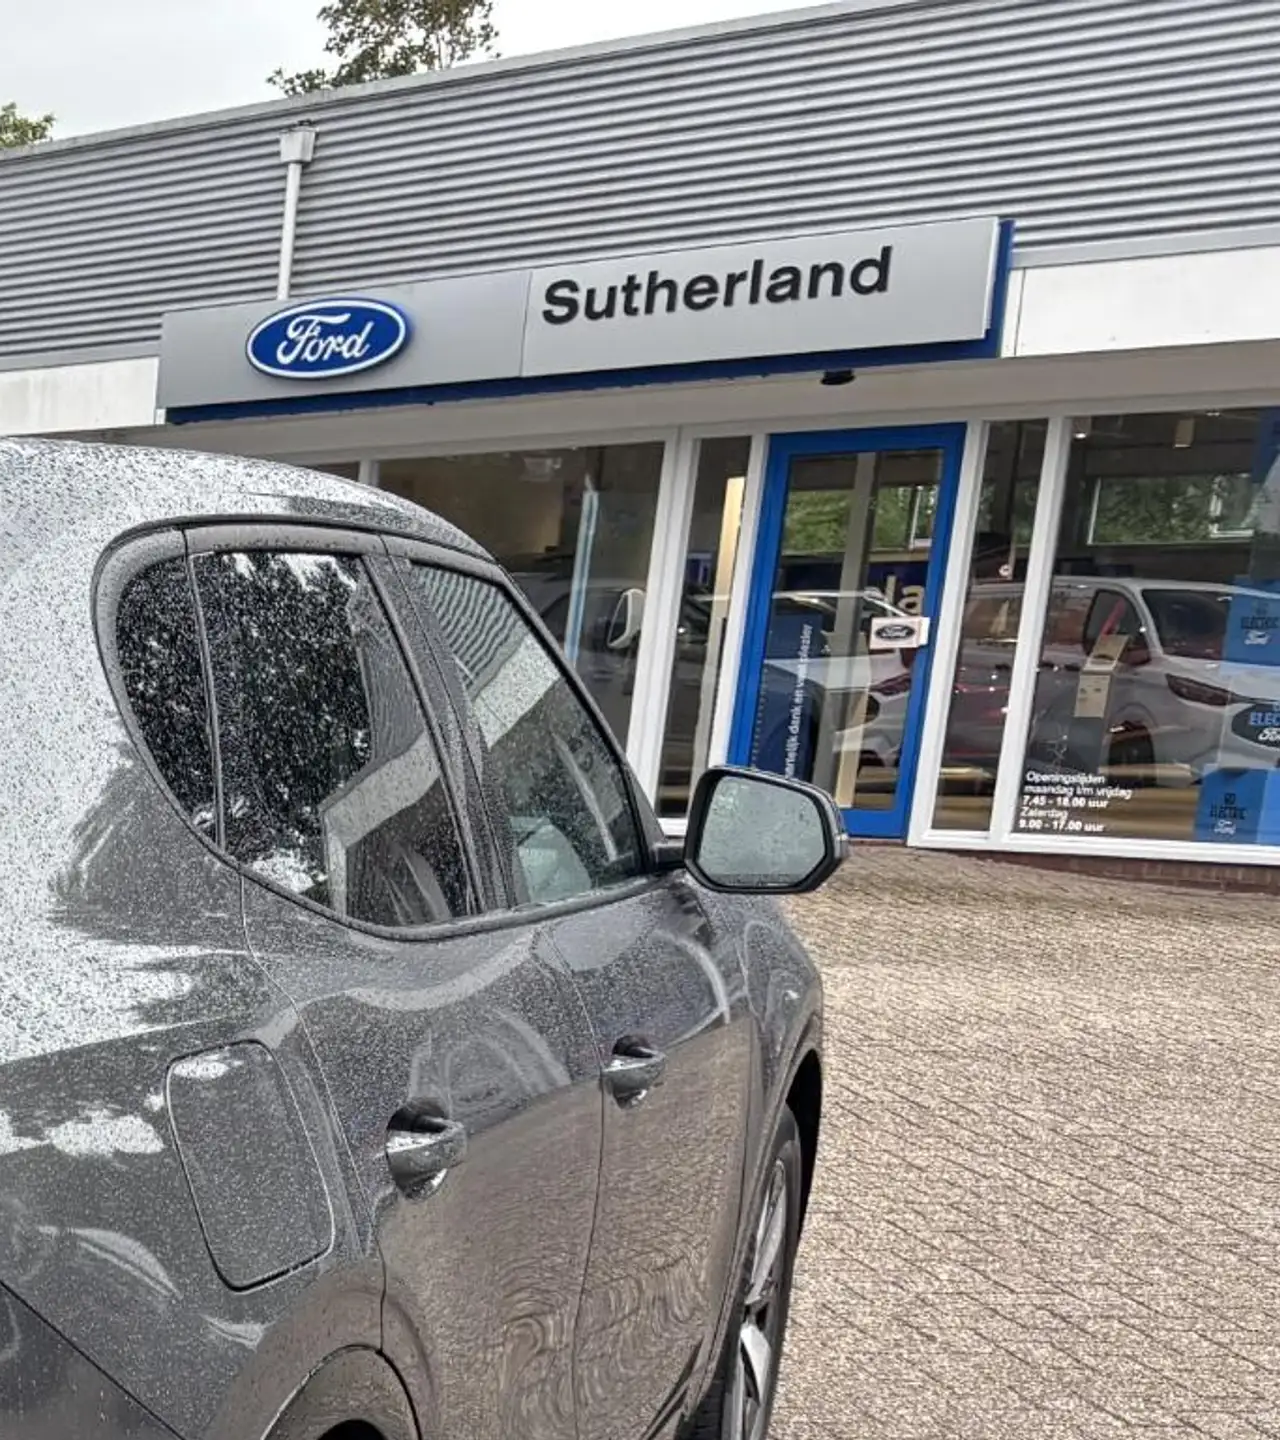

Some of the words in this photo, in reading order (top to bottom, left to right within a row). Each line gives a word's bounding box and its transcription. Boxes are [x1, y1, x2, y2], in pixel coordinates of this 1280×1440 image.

[541, 246, 893, 327] Sutherland
[273, 313, 372, 366] Ford
[1026, 771, 1105, 787] Openingstijden
[1024, 785, 1074, 798] maandag
[1096, 786, 1132, 800] vrijdag
[1088, 800, 1109, 808] uur
[1021, 806, 1069, 821] Zaterdag
[1053, 820, 1082, 831] 17.00
[1084, 823, 1105, 832] uur
